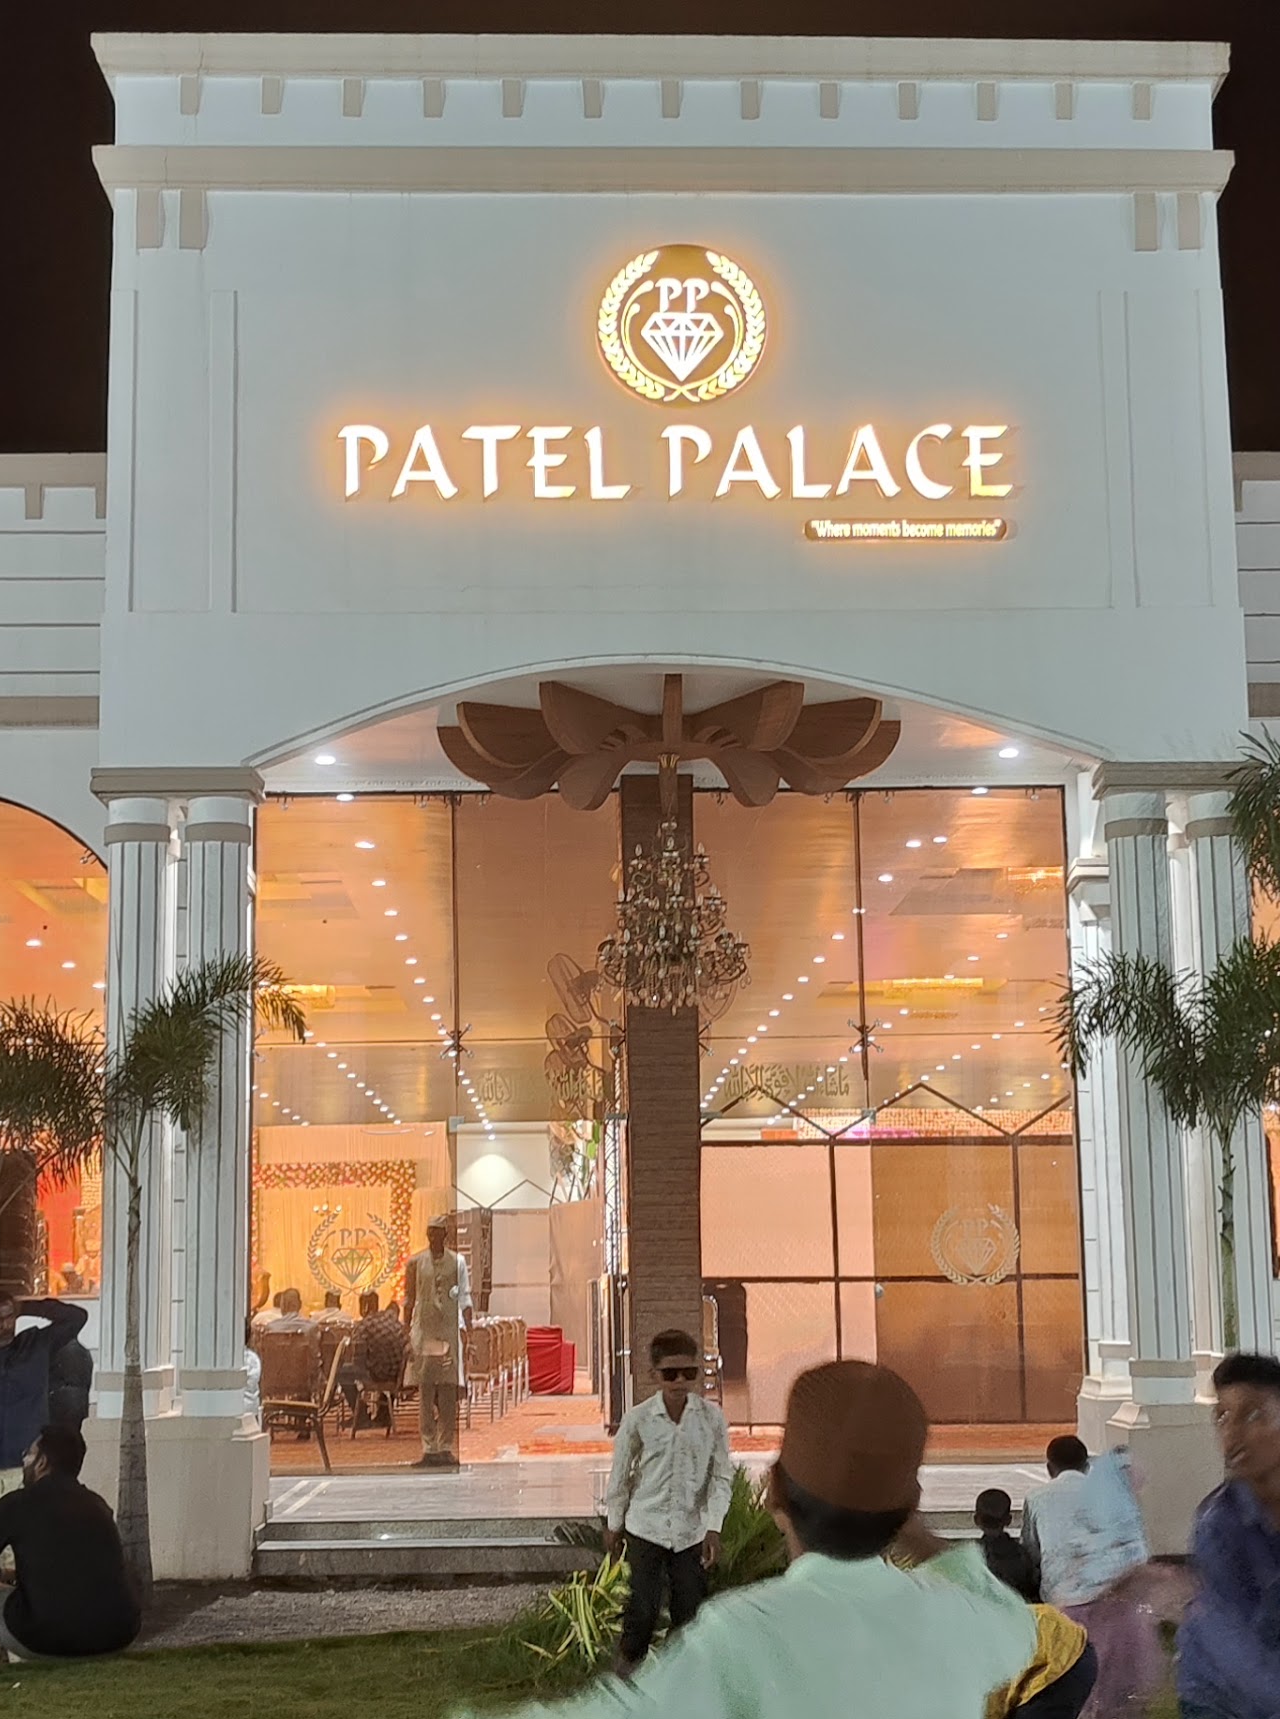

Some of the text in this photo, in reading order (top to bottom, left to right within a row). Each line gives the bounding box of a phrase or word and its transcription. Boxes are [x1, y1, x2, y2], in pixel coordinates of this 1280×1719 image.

[655, 278, 710, 313] PP
[337, 423, 1017, 502] PATEL PALACE
[852, 521, 901, 538] moments
[902, 519, 944, 538] become
[339, 1228, 367, 1246] PP
